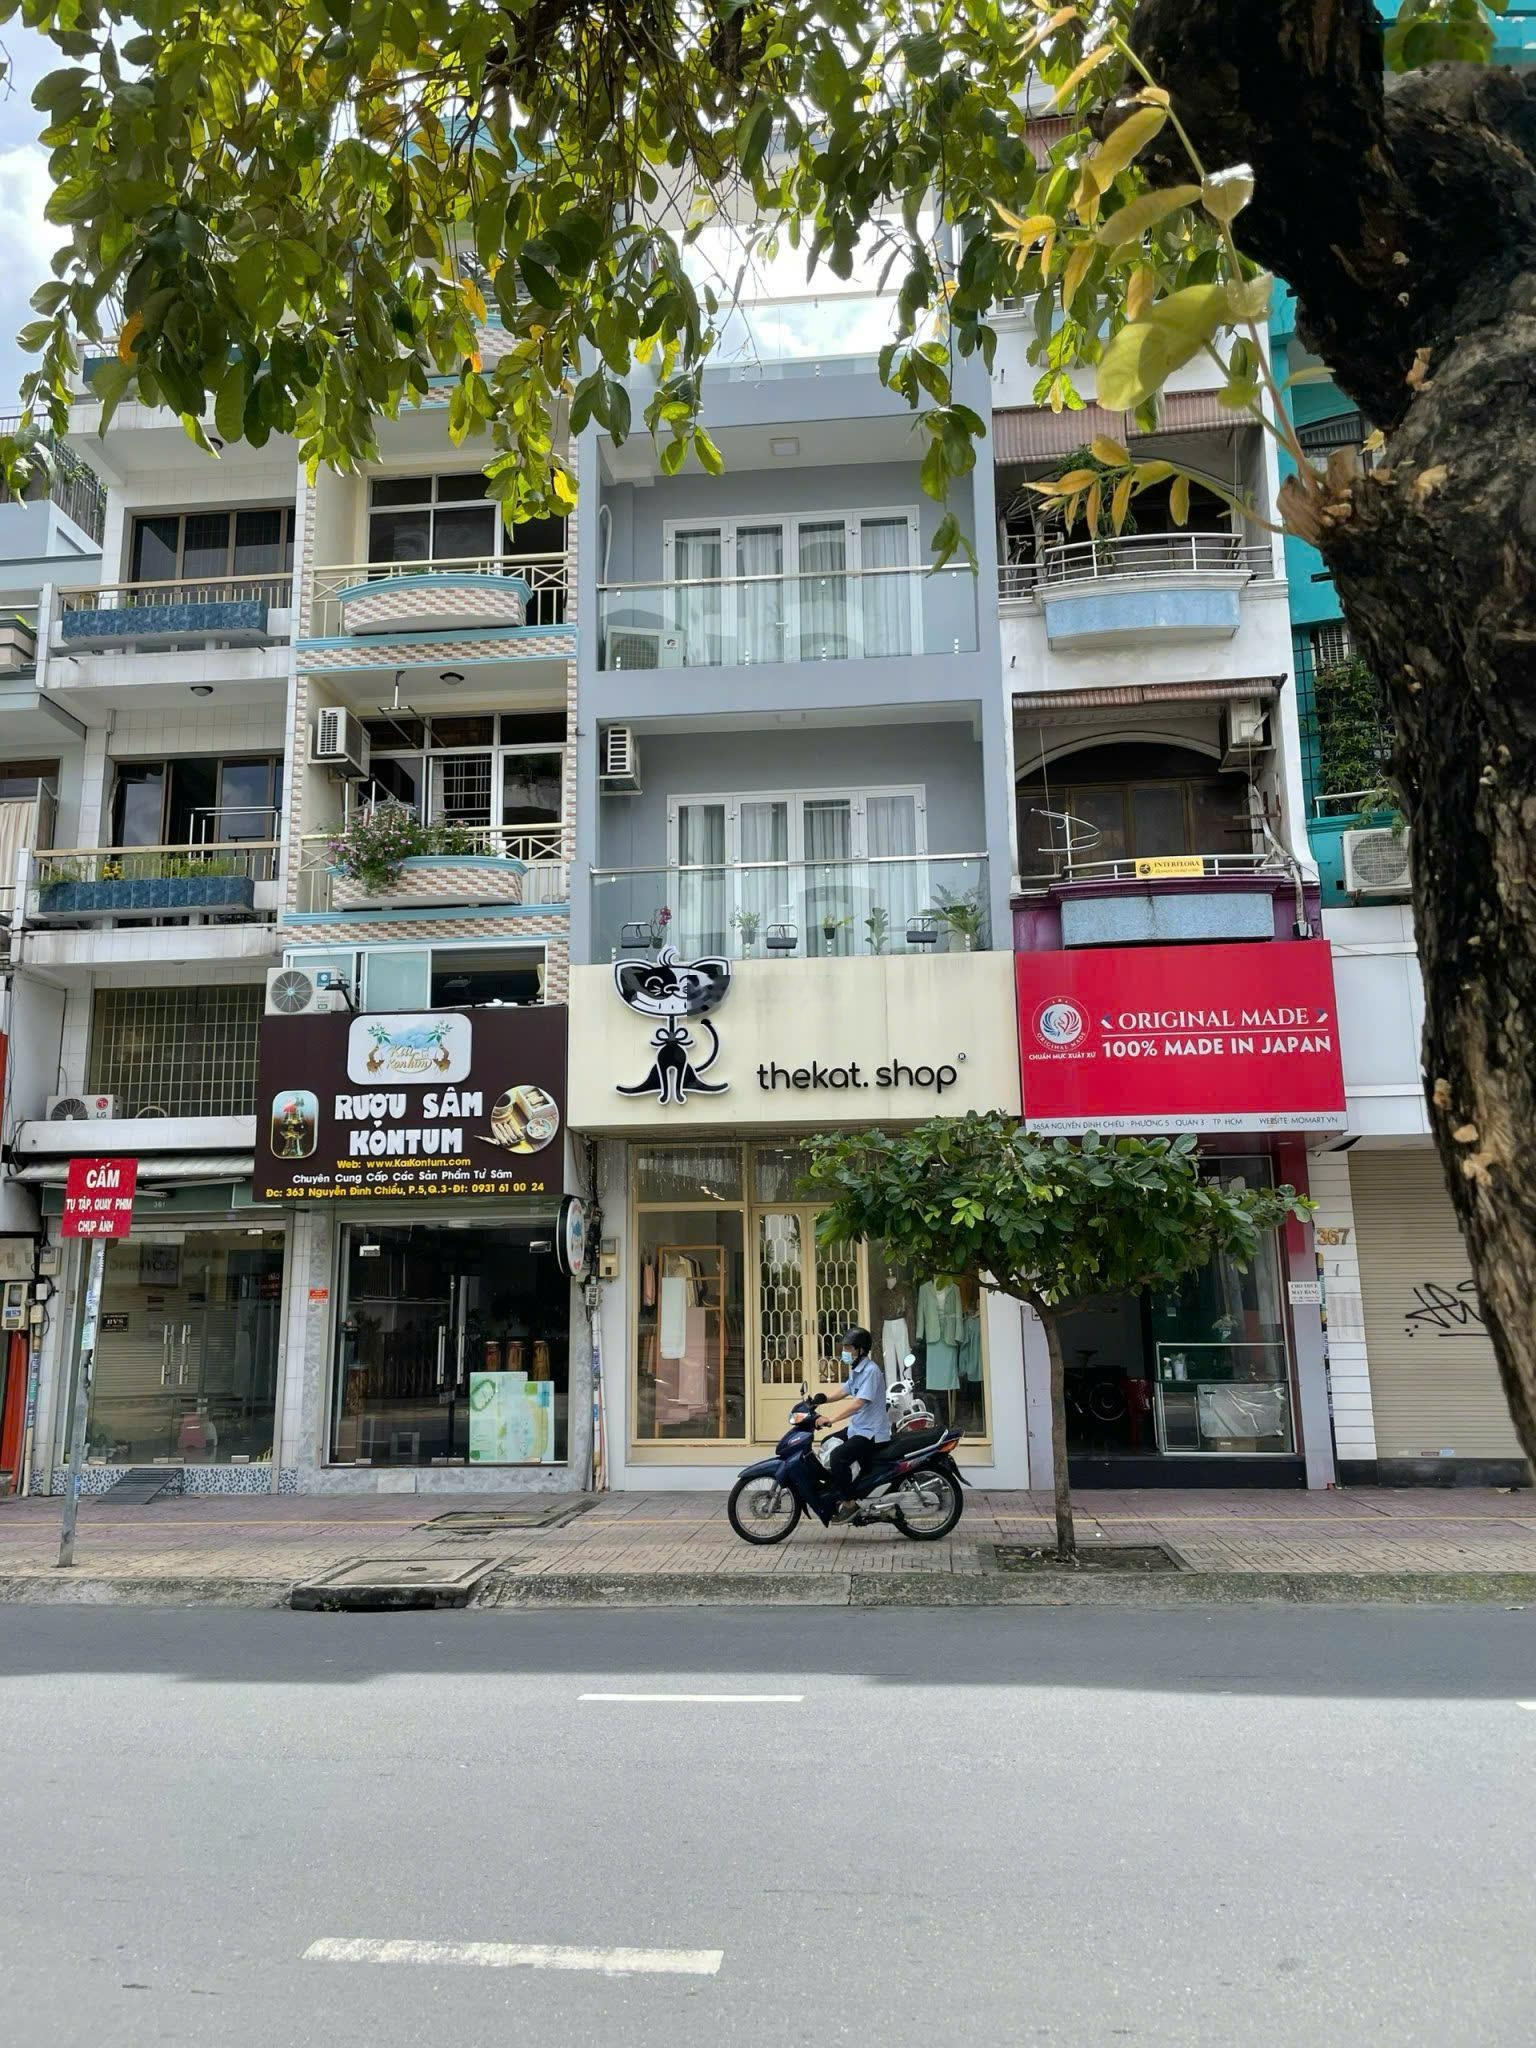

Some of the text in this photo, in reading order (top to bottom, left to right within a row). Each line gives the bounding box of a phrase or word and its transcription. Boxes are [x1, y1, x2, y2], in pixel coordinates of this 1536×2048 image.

[1118, 1008, 1309, 1030] ORIGINAL MADE
[1102, 1036, 1331, 1057] 100% MADE IN JAPAN
[422, 1086, 483, 1119] SÂM
[96, 1111, 107, 1119] LG
[336, 1159, 361, 1169] Web:
[86, 1162, 120, 1189] CẤM
[292, 1174, 330, 1184] Chuyên
[335, 1173, 362, 1184] Cung
[366, 1170, 388, 1182] Cấp
[393, 1170, 415, 1181] Các
[418, 1169, 438, 1180] Sản
[442, 1168, 470, 1180] Phẩm
[490, 1168, 513, 1179] Sâm
[266, 1188, 282, 1198] Đc:
[286, 1186, 304, 1197] 363
[471, 1183, 495, 1193] 0931
[499, 1182, 509, 1192] 61
[513, 1182, 526, 1192] 00
[531, 1181, 545, 1192] 24
[1316, 1228, 1351, 1246] 367
